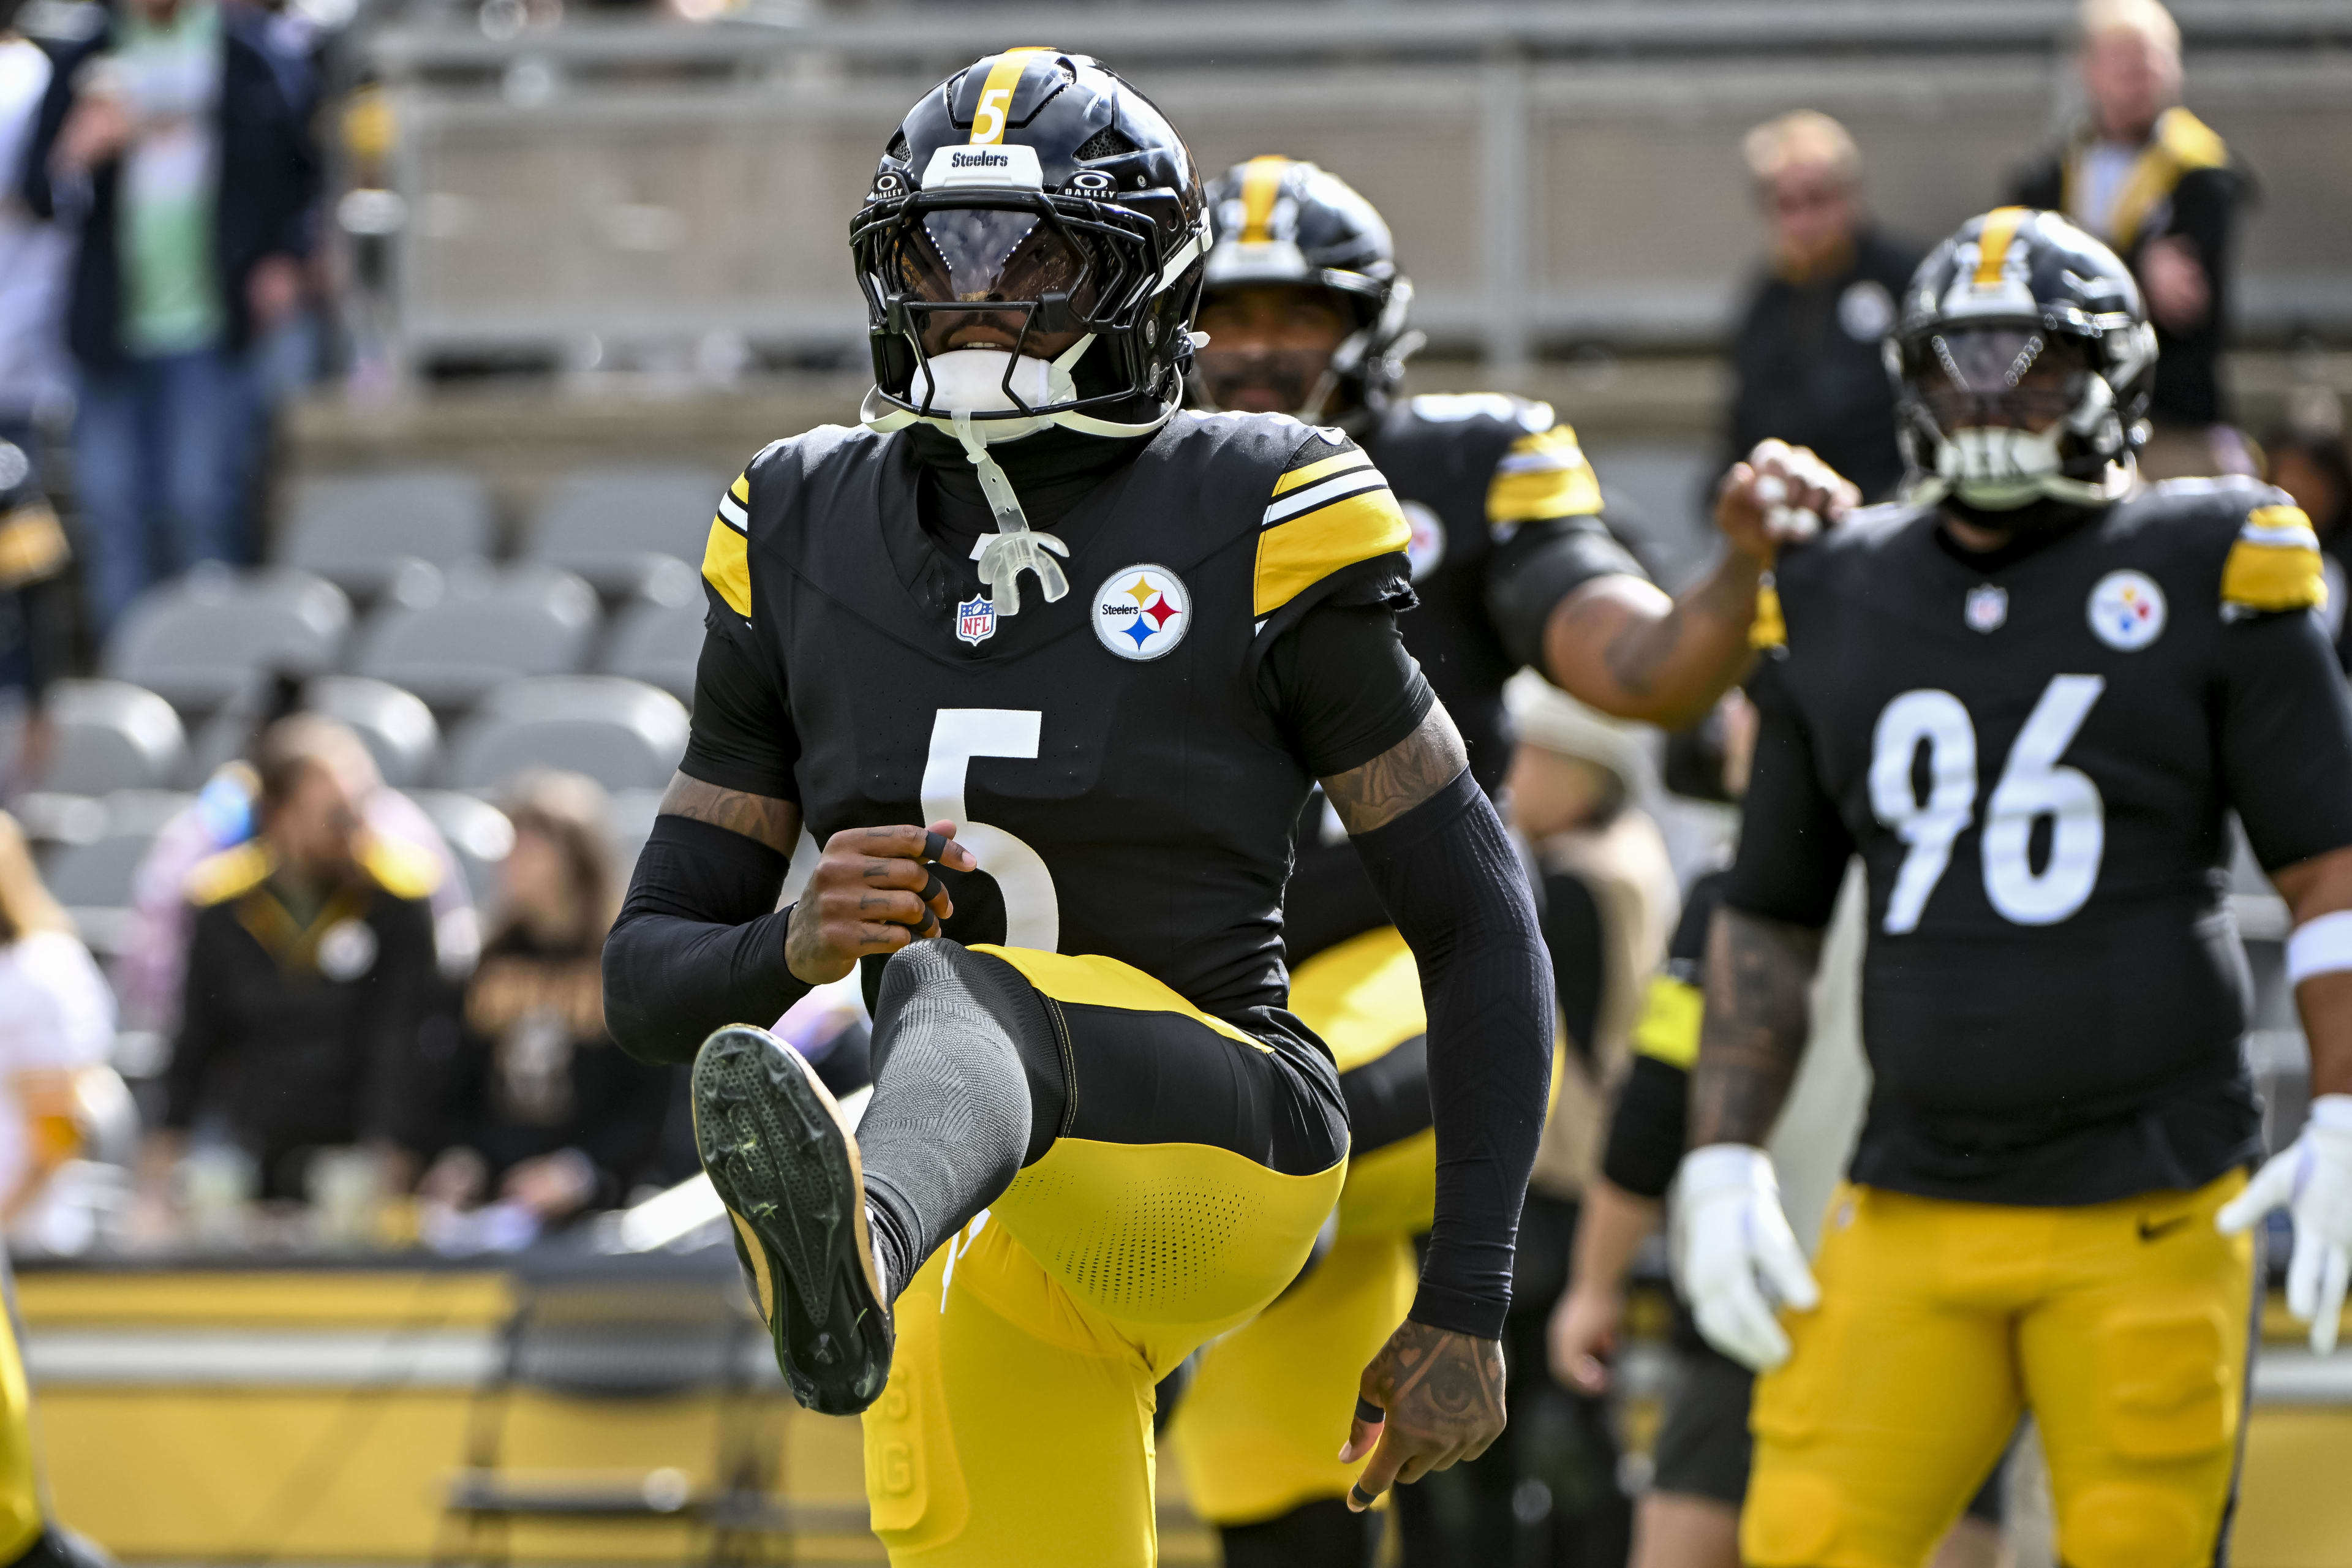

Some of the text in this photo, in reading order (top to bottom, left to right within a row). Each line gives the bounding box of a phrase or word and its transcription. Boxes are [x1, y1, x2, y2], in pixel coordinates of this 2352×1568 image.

[970, 88, 1010, 144] 5
[951, 149, 1008, 168] Steelers
[875, 188, 903, 200] OAKLEY
[1065, 187, 1116, 198] OAKLEY
[1102, 603, 1139, 615] Steelers
[962, 616, 990, 636] NFL
[1868, 673, 2107, 935] 96
[921, 708, 1059, 954] 5
